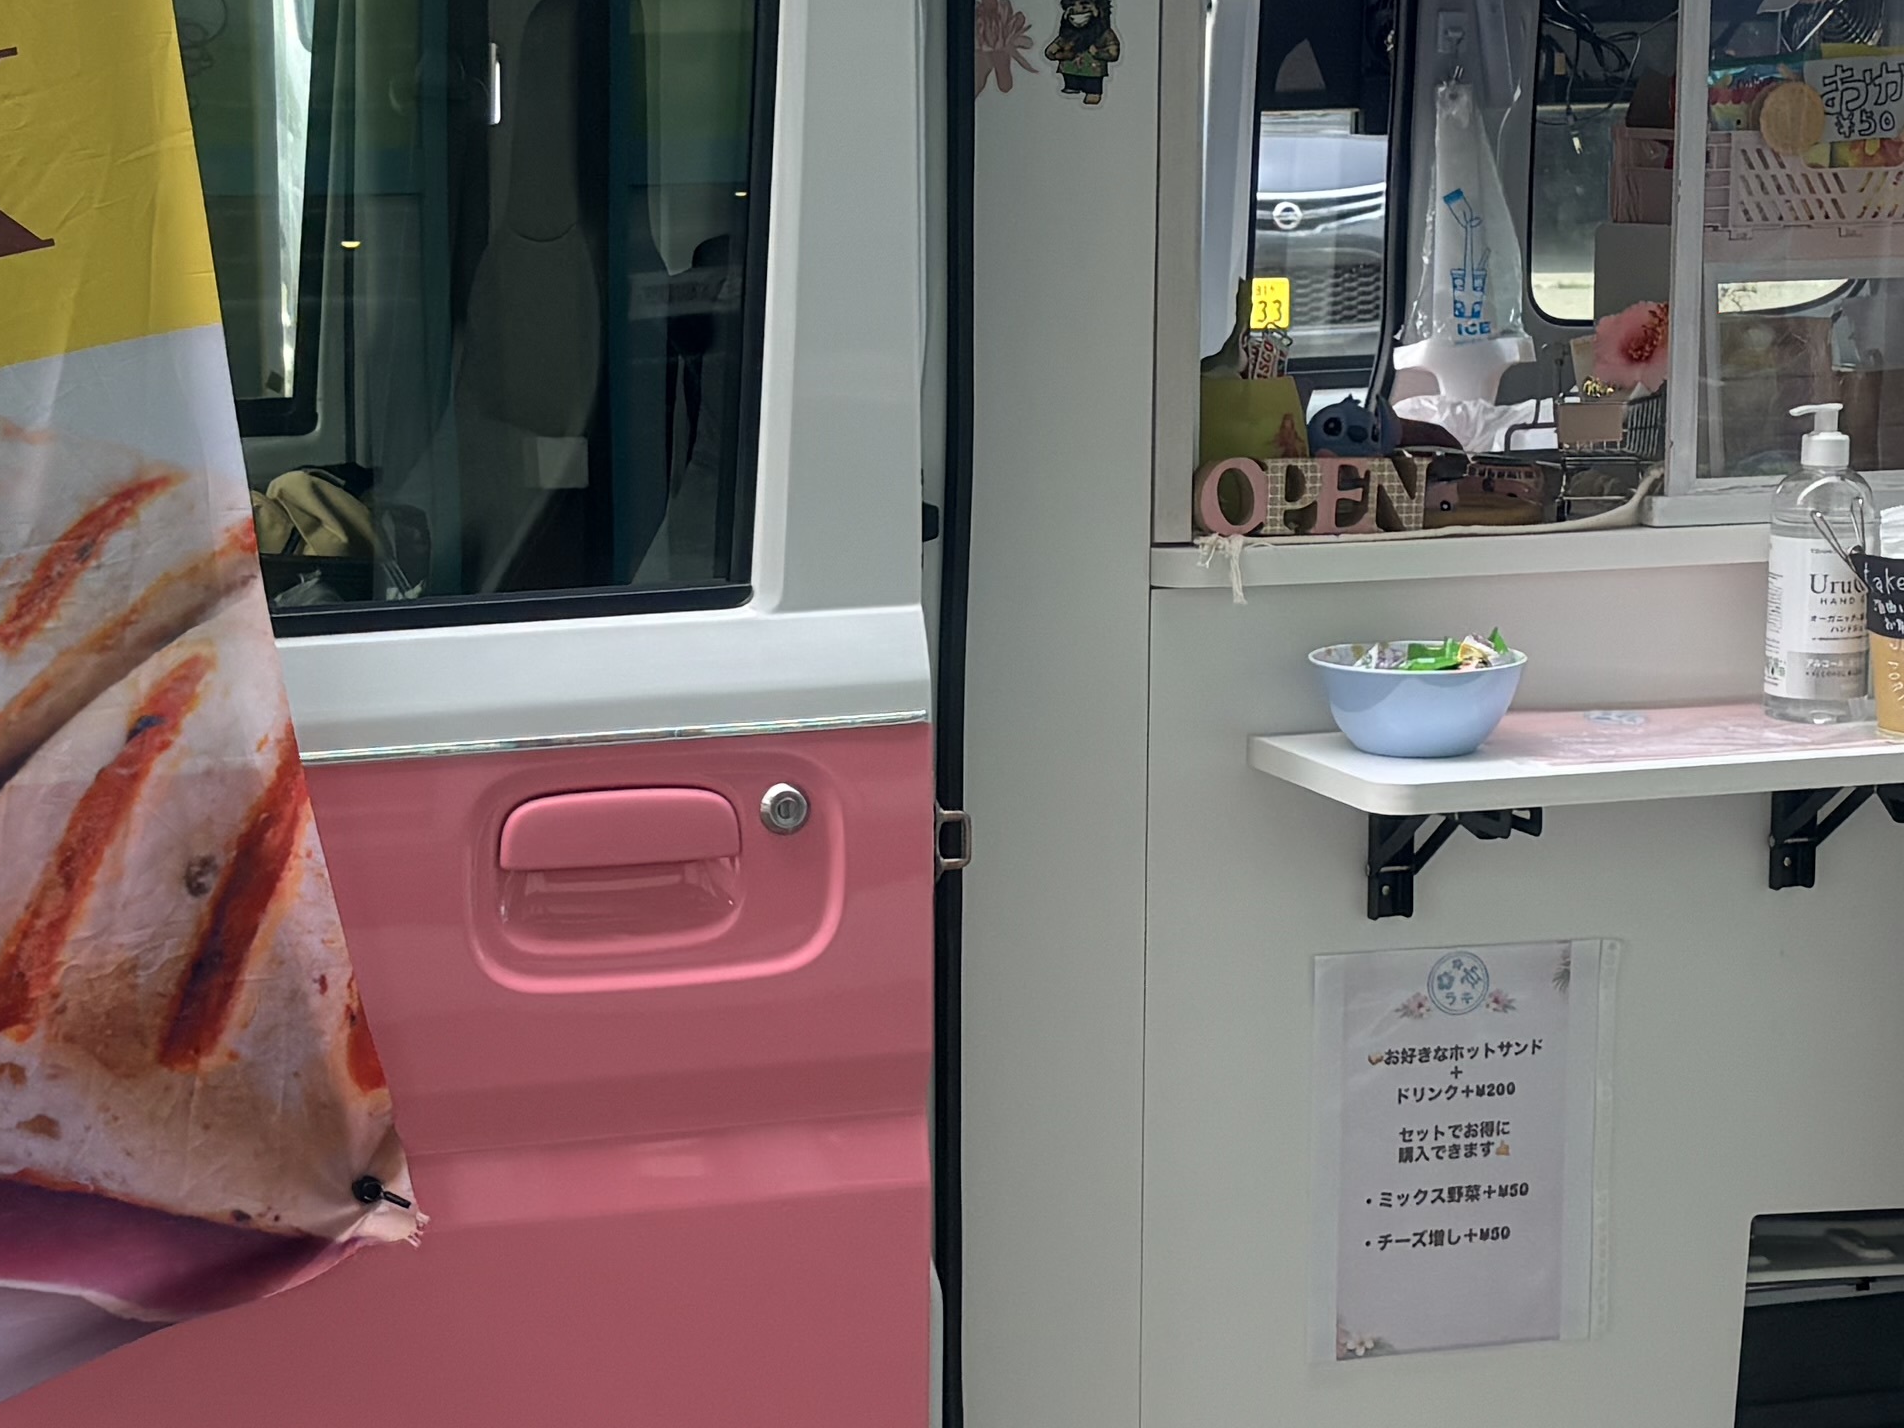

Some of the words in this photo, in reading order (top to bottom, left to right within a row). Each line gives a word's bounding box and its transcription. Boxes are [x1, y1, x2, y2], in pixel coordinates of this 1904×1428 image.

[1836, 110, 1896, 138] ¥50
[1457, 322, 1491, 336] ICE
[1200, 456, 1432, 537] OPEN
[1820, 597, 1856, 606] HAND
[1383, 1038, 1543, 1065] お好きなホットサンド
[1397, 1081, 1516, 1105] ドリンク+¥200
[1399, 1120, 1511, 1143] セットでお得に
[1398, 1141, 1495, 1164] 購入できます
